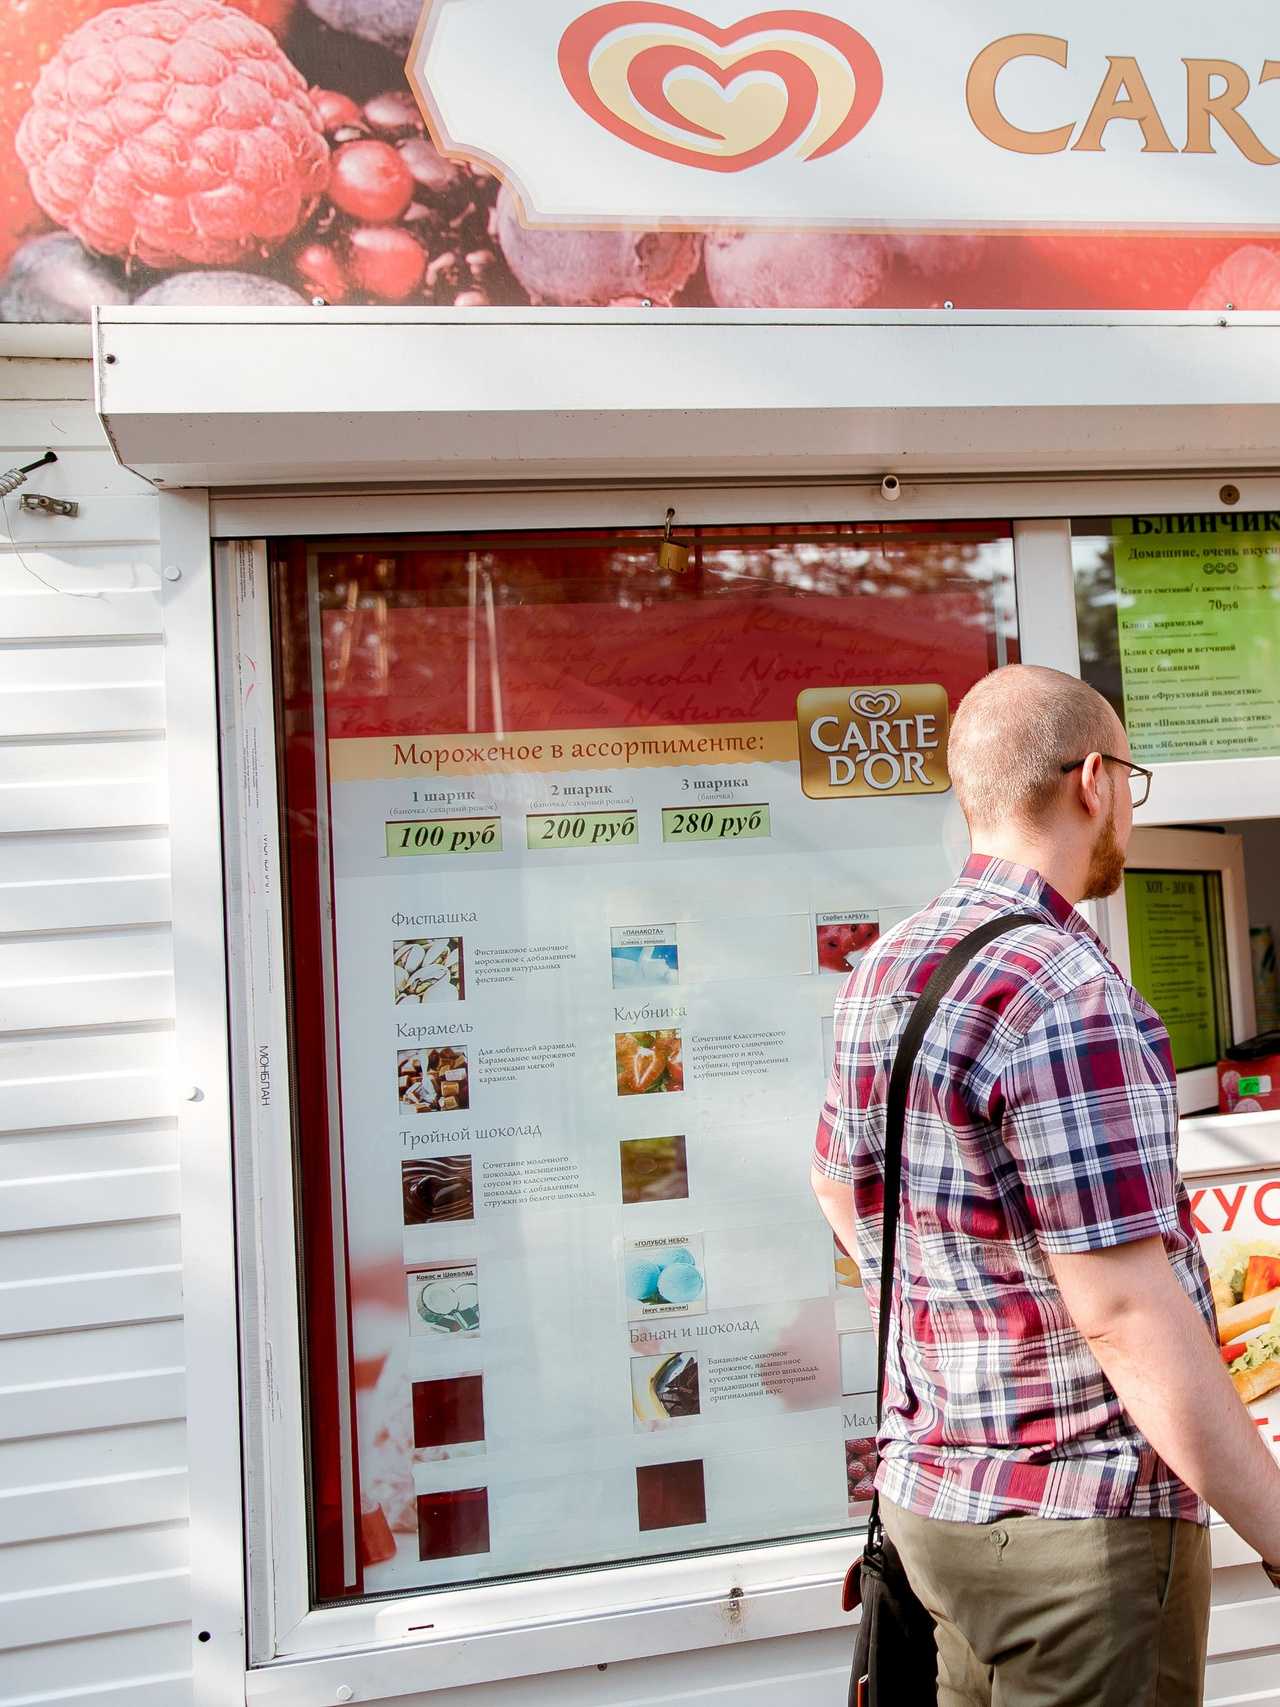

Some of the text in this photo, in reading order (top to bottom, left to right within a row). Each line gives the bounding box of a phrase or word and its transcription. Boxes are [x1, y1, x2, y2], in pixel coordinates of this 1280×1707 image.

[1128, 547, 1200, 561] Домашние,
[1203, 546, 1239, 557] очень
[1208, 599, 1239, 611] 70руб
[1154, 620, 1204, 630] карамелью
[809, 714, 939, 756] CARTE
[392, 736, 764, 771] Мороженое в ассортименте:
[828, 749, 933, 790] D'OR
[551, 784, 613, 799] 2 шарик
[681, 777, 749, 792] 3 шарика
[412, 790, 476, 806] 1 шарик
[697, 791, 734, 802] (баночка)
[541, 816, 636, 843] 200 руб
[671, 810, 762, 838] 280 руб
[398, 824, 496, 851] 100 руб
[391, 911, 478, 927] Фисташка
[474, 943, 569, 957] Фисташковое сливочное
[474, 956, 519, 967] мороженое
[526, 952, 577, 963] добавлением
[474, 962, 561, 976] кусочков натуральных
[612, 1004, 687, 1025] Клубника
[396, 1022, 474, 1042] Карамель
[691, 1029, 786, 1044] Сочетание классического
[477, 1048, 493, 1056] Для
[494, 1044, 537, 1054] любителей
[692, 1037, 784, 1053] клубничного сливочного
[478, 1051, 576, 1065] Карамельное мороженое
[692, 1050, 739, 1062] мороженого
[747, 1049, 764, 1059] ягод
[731, 1056, 789, 1069] приправленных
[259, 1045, 271, 1106] МОНБЛАН
[484, 1065, 526, 1075] кусочками
[693, 1068, 740, 1080] клубничным
[399, 1123, 542, 1150] Тройной шоколад
[482, 1155, 569, 1170] Сочетание молочного
[524, 1164, 578, 1176] насыщенного
[483, 1179, 512, 1188] соусом
[523, 1172, 579, 1184] классического
[483, 1188, 522, 1198] шоколада
[529, 1182, 579, 1194] добавлением
[484, 1197, 518, 1208] стружки
[529, 1192, 556, 1203] белого
[629, 1319, 760, 1344] Банан и шоколад
[707, 1350, 788, 1366] Банановое сливочное
[754, 1358, 802, 1370] насыщенное
[708, 1373, 748, 1383] кусочками
[709, 1373, 817, 1393] придающими неповторимый
[709, 1390, 764, 1402] оригинальный
[843, 1413, 885, 1428] Мал
